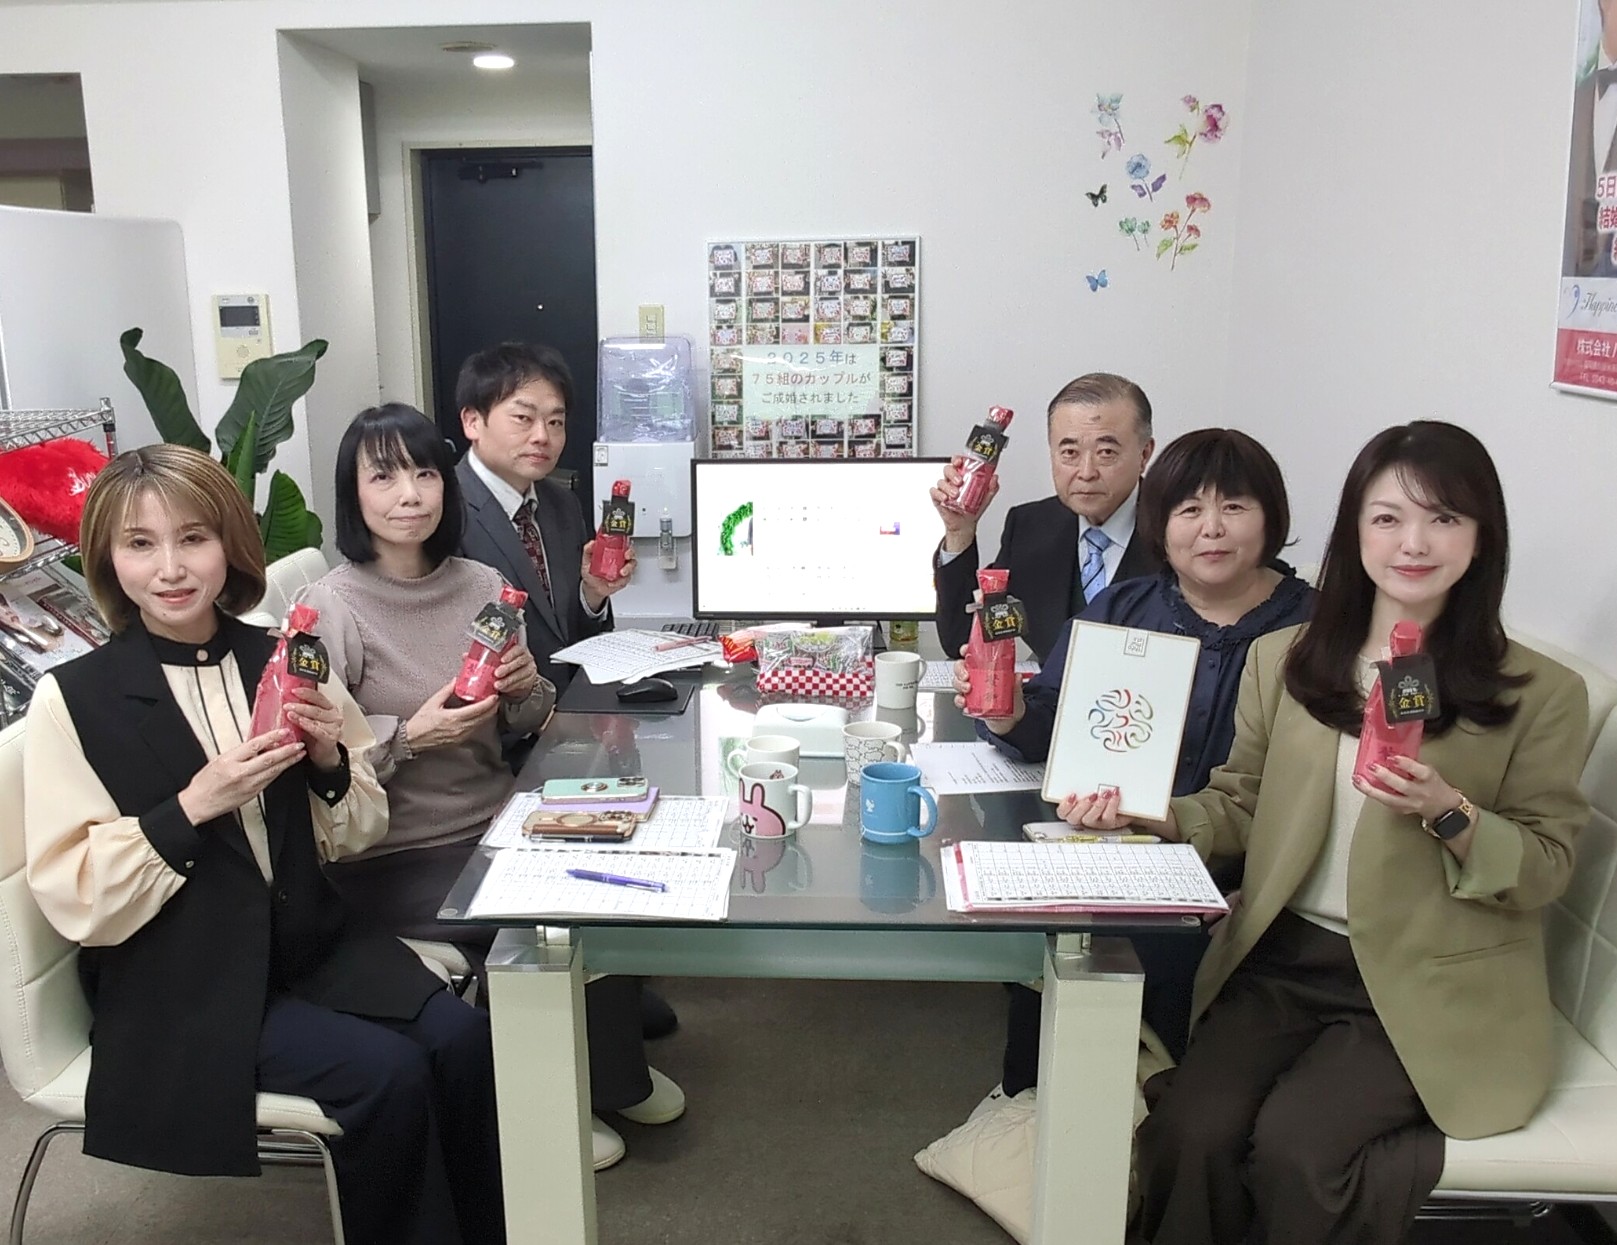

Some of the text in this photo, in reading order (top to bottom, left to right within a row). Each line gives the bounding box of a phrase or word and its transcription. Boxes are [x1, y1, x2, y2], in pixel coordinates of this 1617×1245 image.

[752, 371, 871, 386] 75組のカップルが
[761, 391, 859, 404] ご成婚されました
